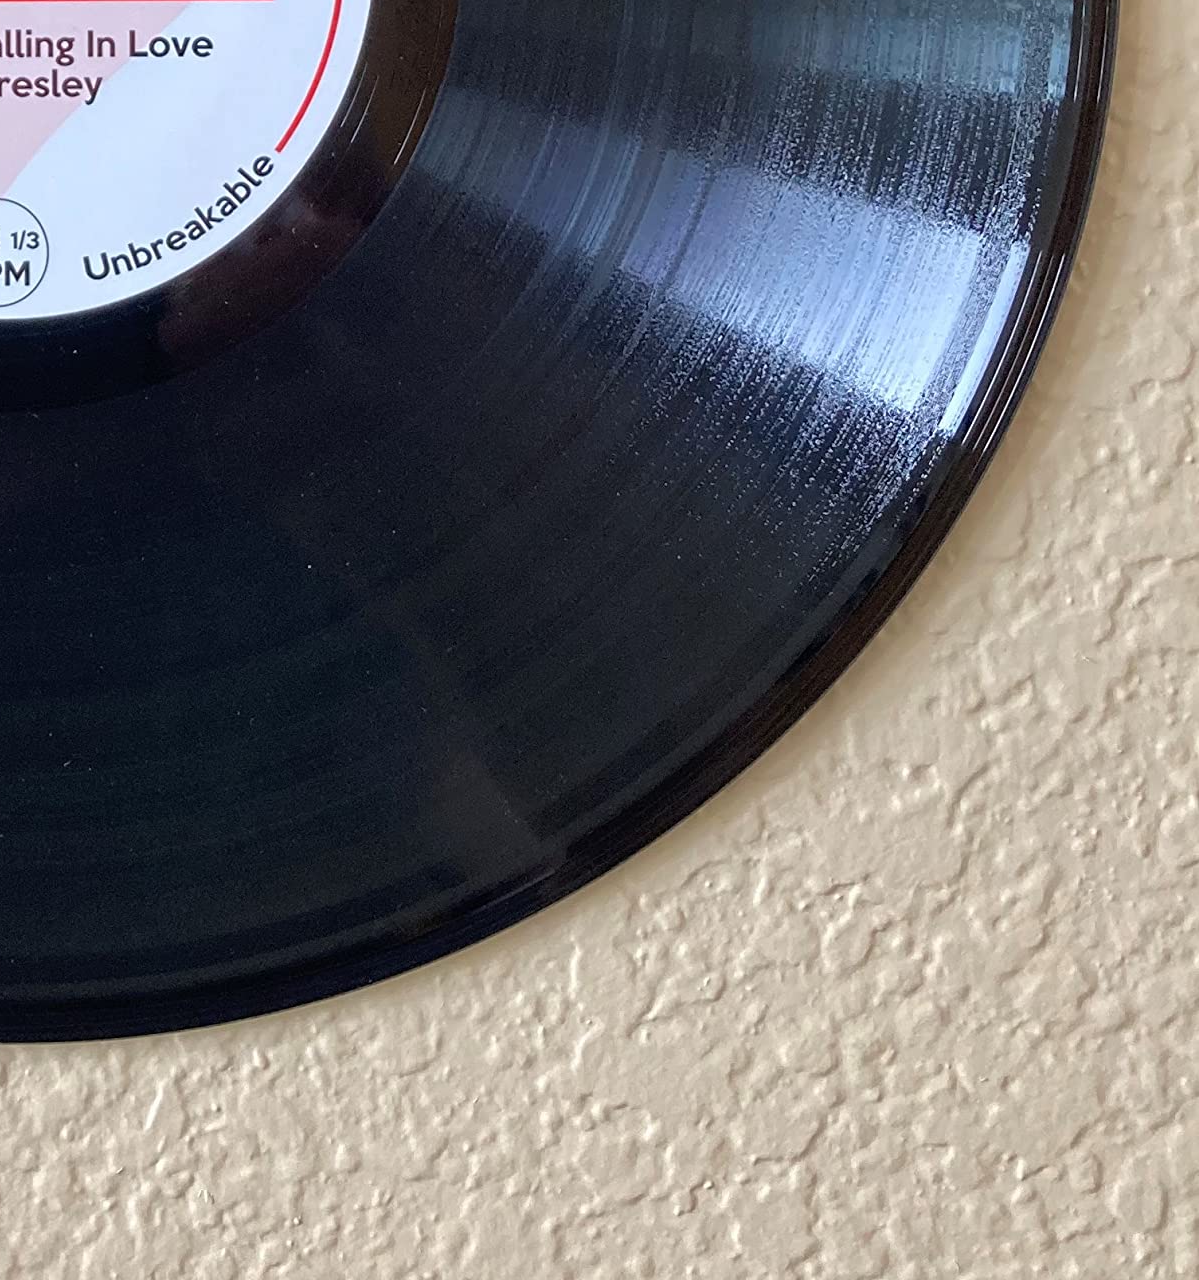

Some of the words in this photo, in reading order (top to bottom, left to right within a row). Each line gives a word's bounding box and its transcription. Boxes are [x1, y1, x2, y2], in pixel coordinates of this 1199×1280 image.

[87, 30, 116, 58] In
[129, 29, 214, 58] Love
[83, 156, 274, 281] Unbreakable
[10, 229, 40, 251] 1/3
